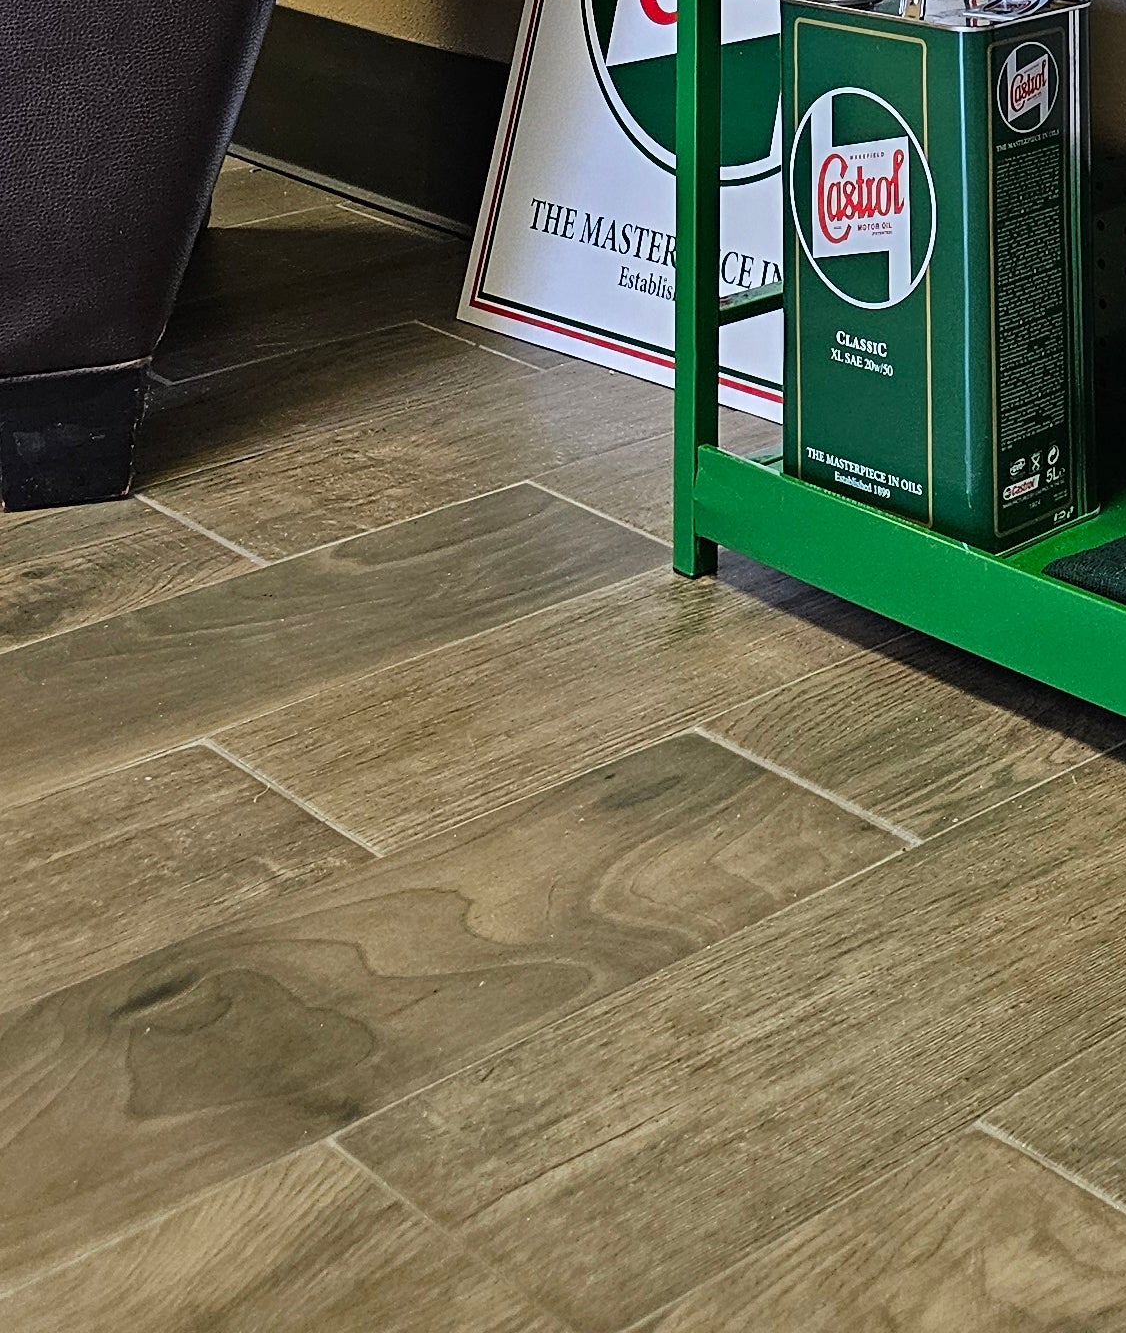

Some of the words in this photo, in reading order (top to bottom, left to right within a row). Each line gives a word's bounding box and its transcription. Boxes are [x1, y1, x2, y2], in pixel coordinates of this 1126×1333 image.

[1010, 59, 1047, 112] Castrol
[817, 148, 905, 244] Castrol
[530, 197, 578, 239] THE
[579, 212, 755, 289] MASTERCE
[857, 222, 880, 231] MOTOR
[881, 222, 893, 230] OIL
[617, 265, 676, 302] Establis
[830, 347, 844, 363] XL
[844, 352, 863, 368] SAE
[864, 357, 894, 377] 20w/50
[806, 446, 825, 463] THE
[826, 453, 887, 483] MASTERPIECE
[888, 474, 900, 487] IN
[900, 478, 923, 496] OILS
[834, 470, 872, 493] Established
